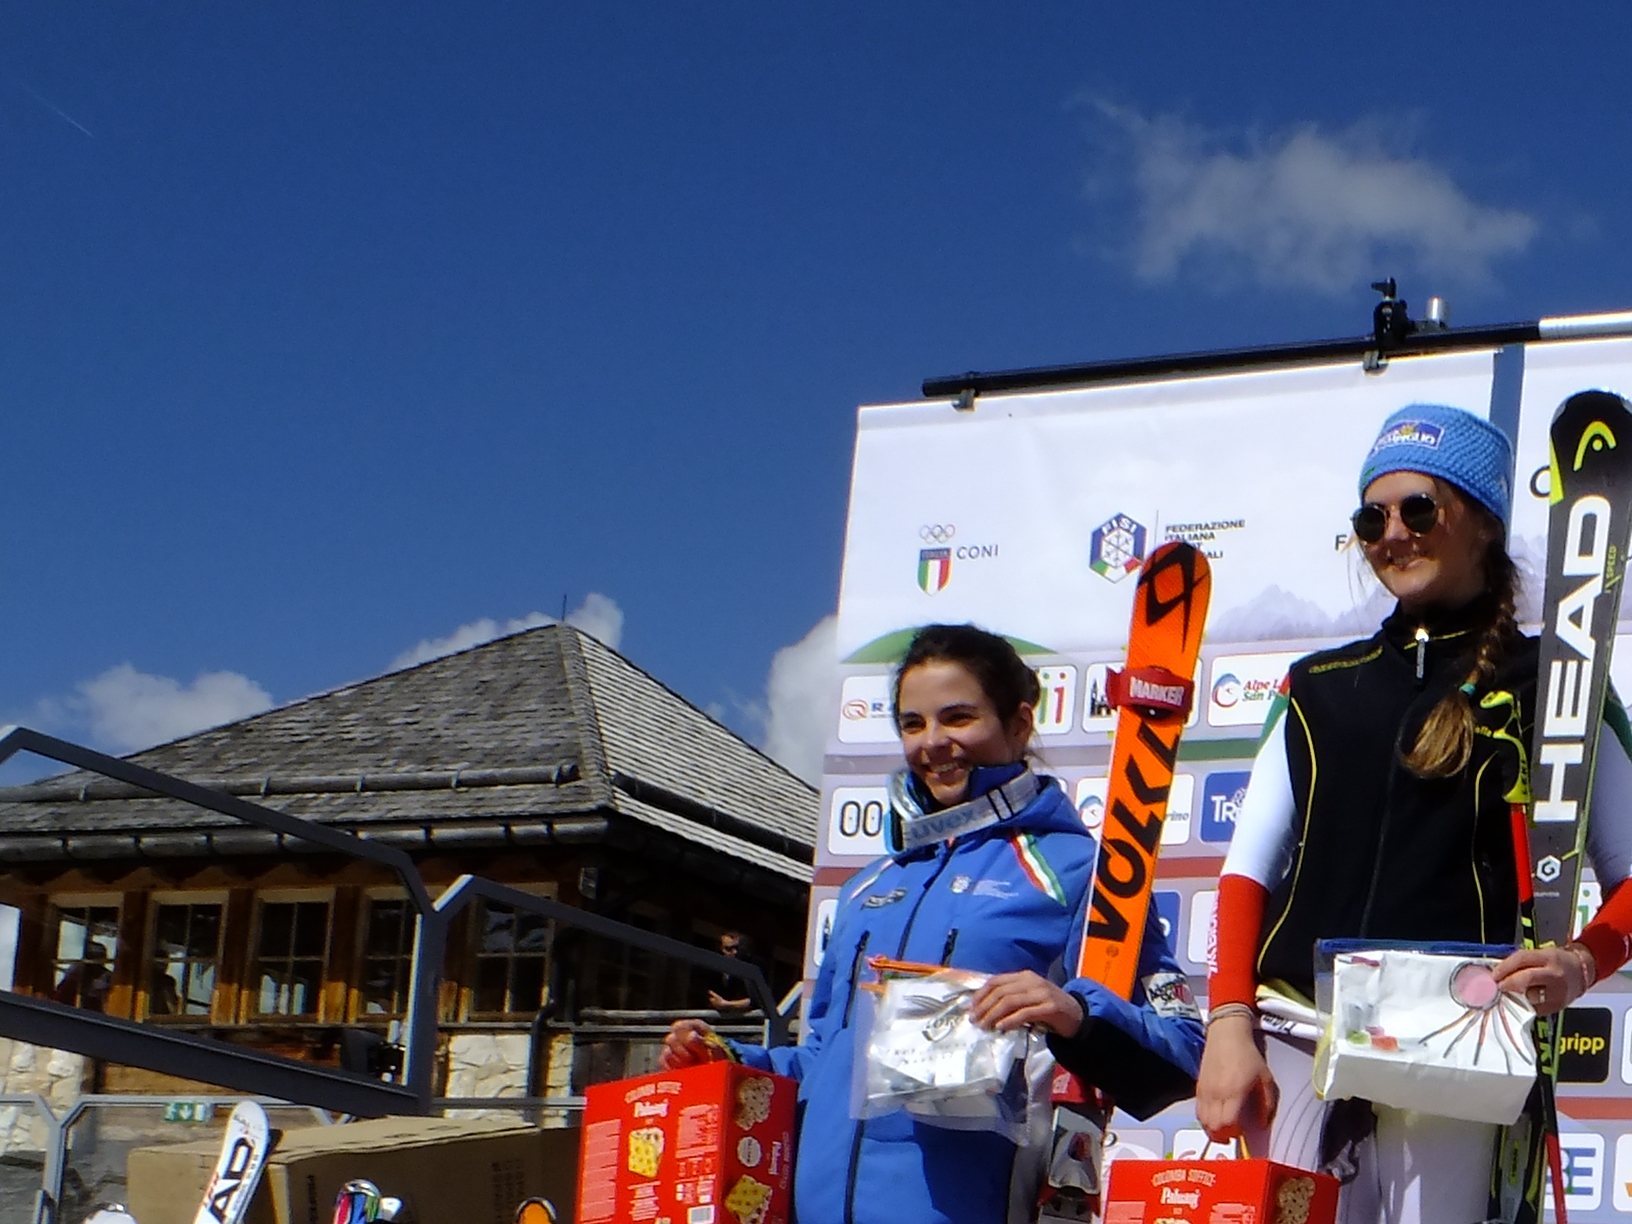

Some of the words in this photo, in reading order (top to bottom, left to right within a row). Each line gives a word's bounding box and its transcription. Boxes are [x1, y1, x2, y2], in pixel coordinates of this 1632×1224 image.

[1101, 515, 1138, 536] FISI
[1165, 519, 1246, 533] FEDERAZIONE
[956, 544, 999, 560] CONI
[1532, 495, 1613, 822] HEAD
[1130, 676, 1184, 706] MARKER
